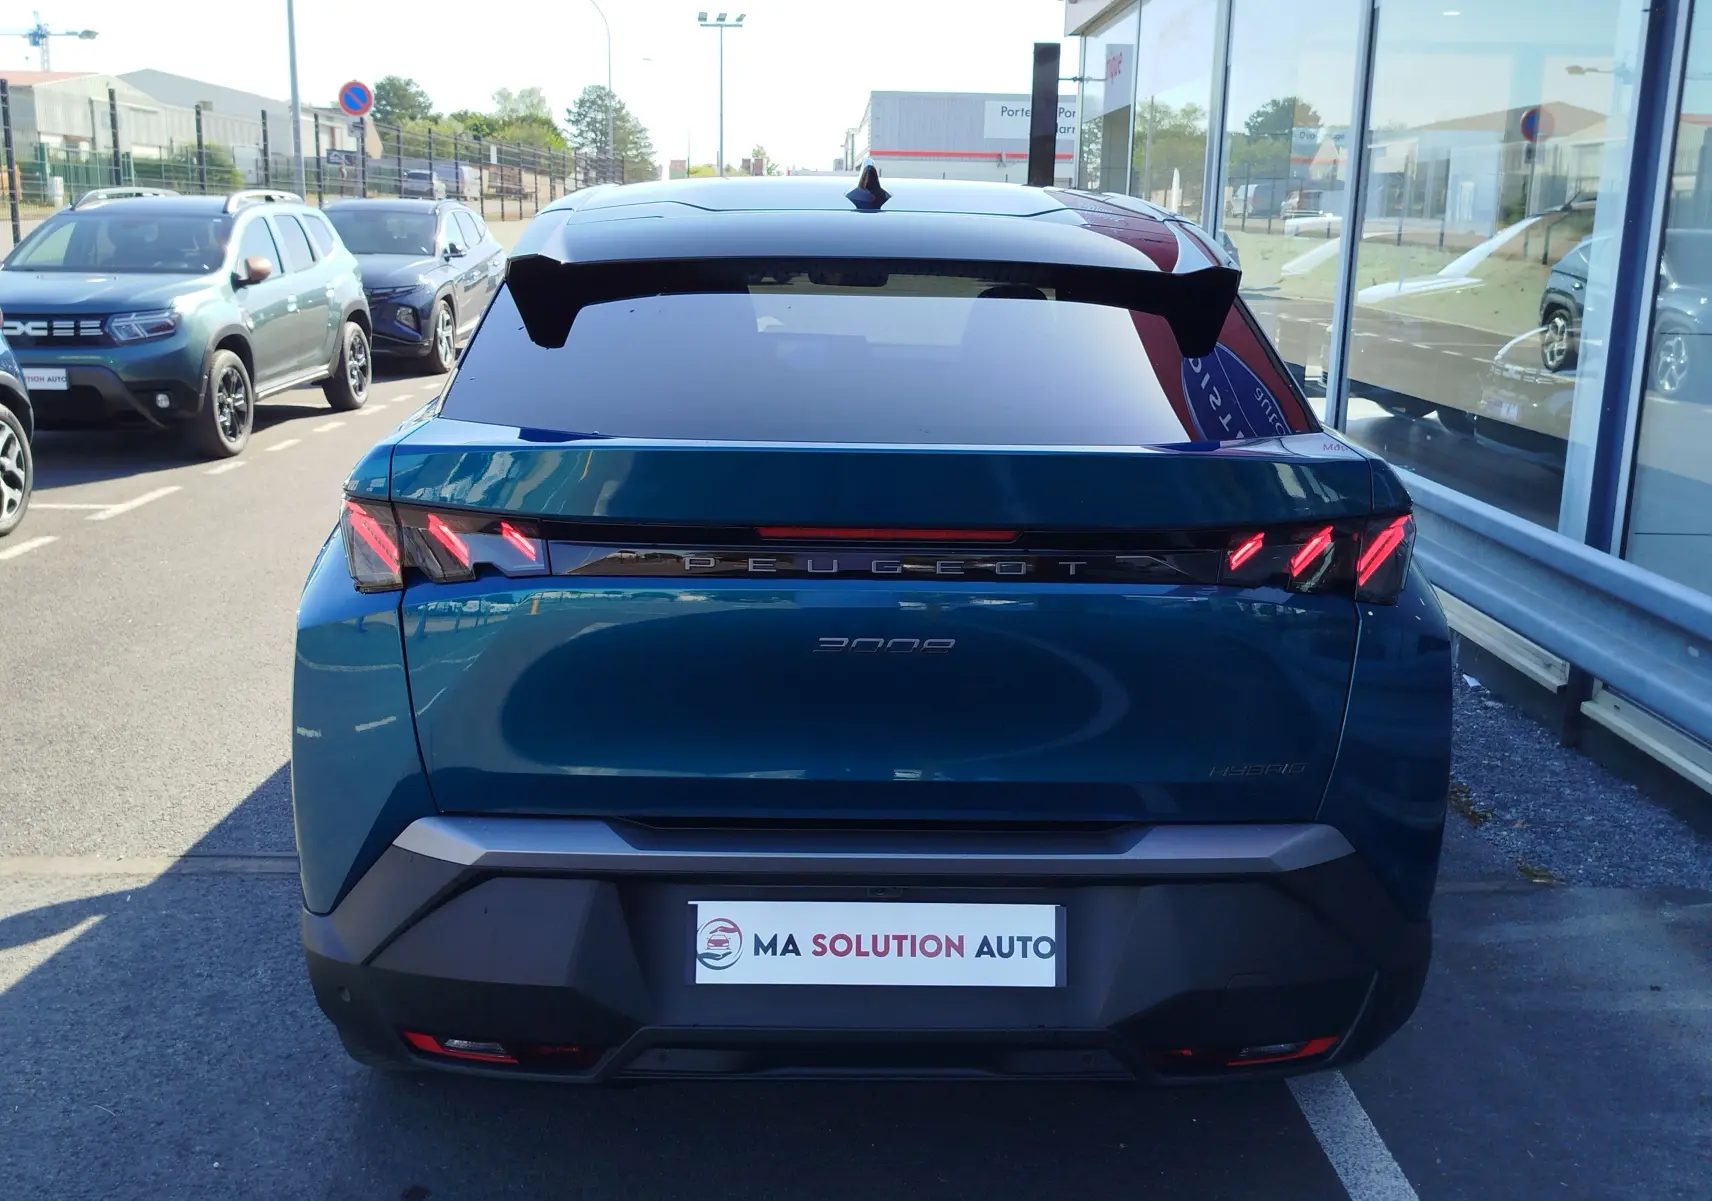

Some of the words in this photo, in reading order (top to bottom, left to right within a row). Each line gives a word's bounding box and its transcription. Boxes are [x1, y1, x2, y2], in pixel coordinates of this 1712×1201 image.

[684, 555, 1087, 576] PEUGEOT
[813, 637, 956, 653] 3008
[1209, 763, 1308, 777] HYBRID
[753, 933, 802, 957] MA
[811, 933, 965, 958] SOLUTION
[974, 935, 1056, 959] AUTO
